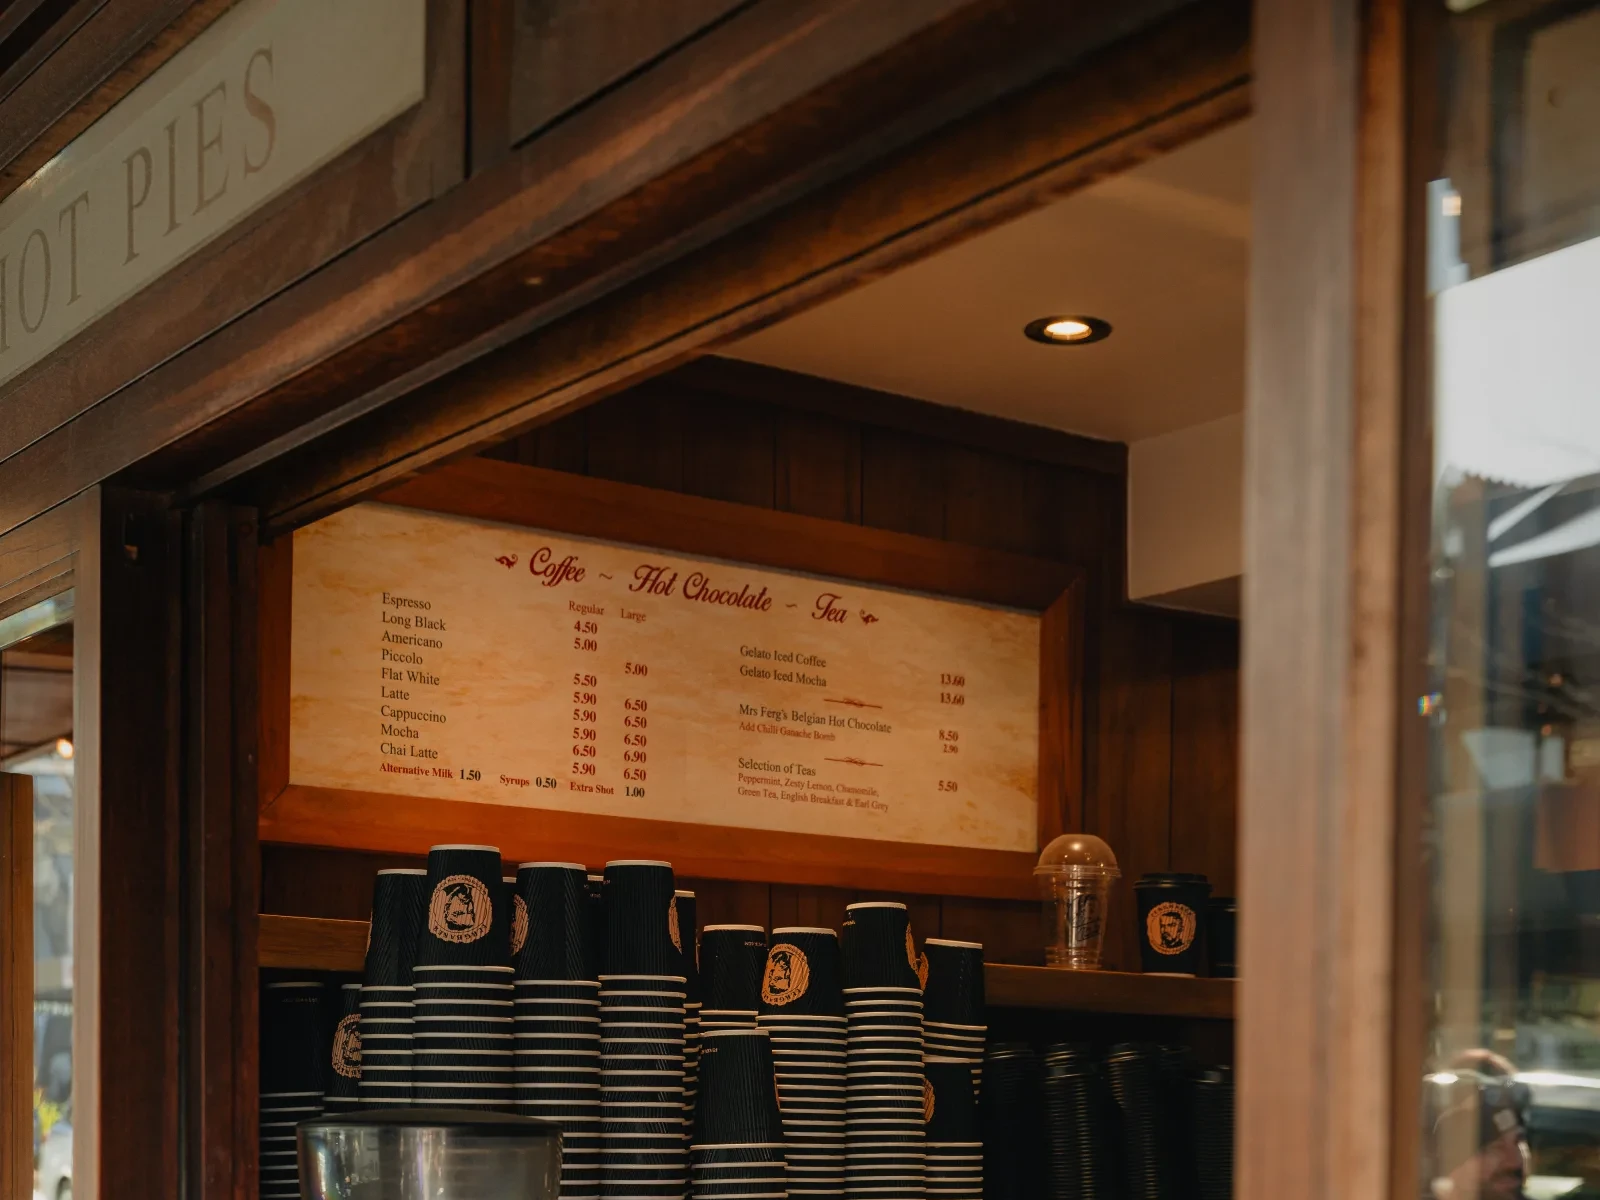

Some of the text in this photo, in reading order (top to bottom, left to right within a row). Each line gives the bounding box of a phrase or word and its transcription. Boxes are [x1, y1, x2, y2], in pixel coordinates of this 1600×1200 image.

[0, 41, 277, 354] OT PIES
[529, 546, 586, 588] Coffee
[629, 564, 679, 597] Hot
[683, 572, 772, 612] Chocolate
[812, 593, 848, 624] Tea
[382, 592, 431, 611] Espresso
[568, 600, 646, 623] Regular Large
[382, 611, 447, 631] Long Black
[574, 621, 598, 634] 4.50
[381, 630, 443, 649] Americano
[574, 638, 598, 652] 5.00
[381, 648, 423, 665] Piccolo
[740, 645, 826, 668] Gelato Iced Coffee
[381, 667, 441, 686] Flat White
[624, 662, 648, 677] 5.00
[739, 665, 827, 687] Gelato Iced Mocha
[573, 674, 597, 688] 5.50
[381, 686, 410, 701] Latte
[572, 692, 597, 706] 5.90
[624, 698, 648, 712] 6.50
[380, 705, 447, 725] Cappuccino
[572, 709, 596, 723] 5.90
[624, 715, 648, 729] 6.50
[739, 704, 892, 734] Mrs Ferg's Belgian Hot Chocolate
[380, 724, 419, 739] Mocha
[572, 727, 596, 741] 5.90
[739, 721, 755, 732] Add
[756, 723, 778, 735] Chilli
[779, 726, 812, 739] Ganache
[938, 730, 959, 742] 8.50
[624, 733, 647, 747] 6.50
[380, 742, 439, 759] Chai Latte
[572, 744, 596, 758] 6.50
[623, 750, 647, 764] 6.90
[379, 762, 481, 781] Alternative Milk 1.50
[572, 762, 596, 776] 5.90
[623, 768, 647, 781] 6.50
[738, 757, 816, 776] Selection of Teas
[499, 774, 557, 789] Syrups 0.50
[569, 780, 645, 799] Extra Shot 1.00
[738, 773, 782, 789] Peppermint,
[784, 777, 805, 791] Zesty
[938, 780, 958, 792] 5.50
[738, 787, 889, 813] Green Tea, English Breakfast & Earl Grey
